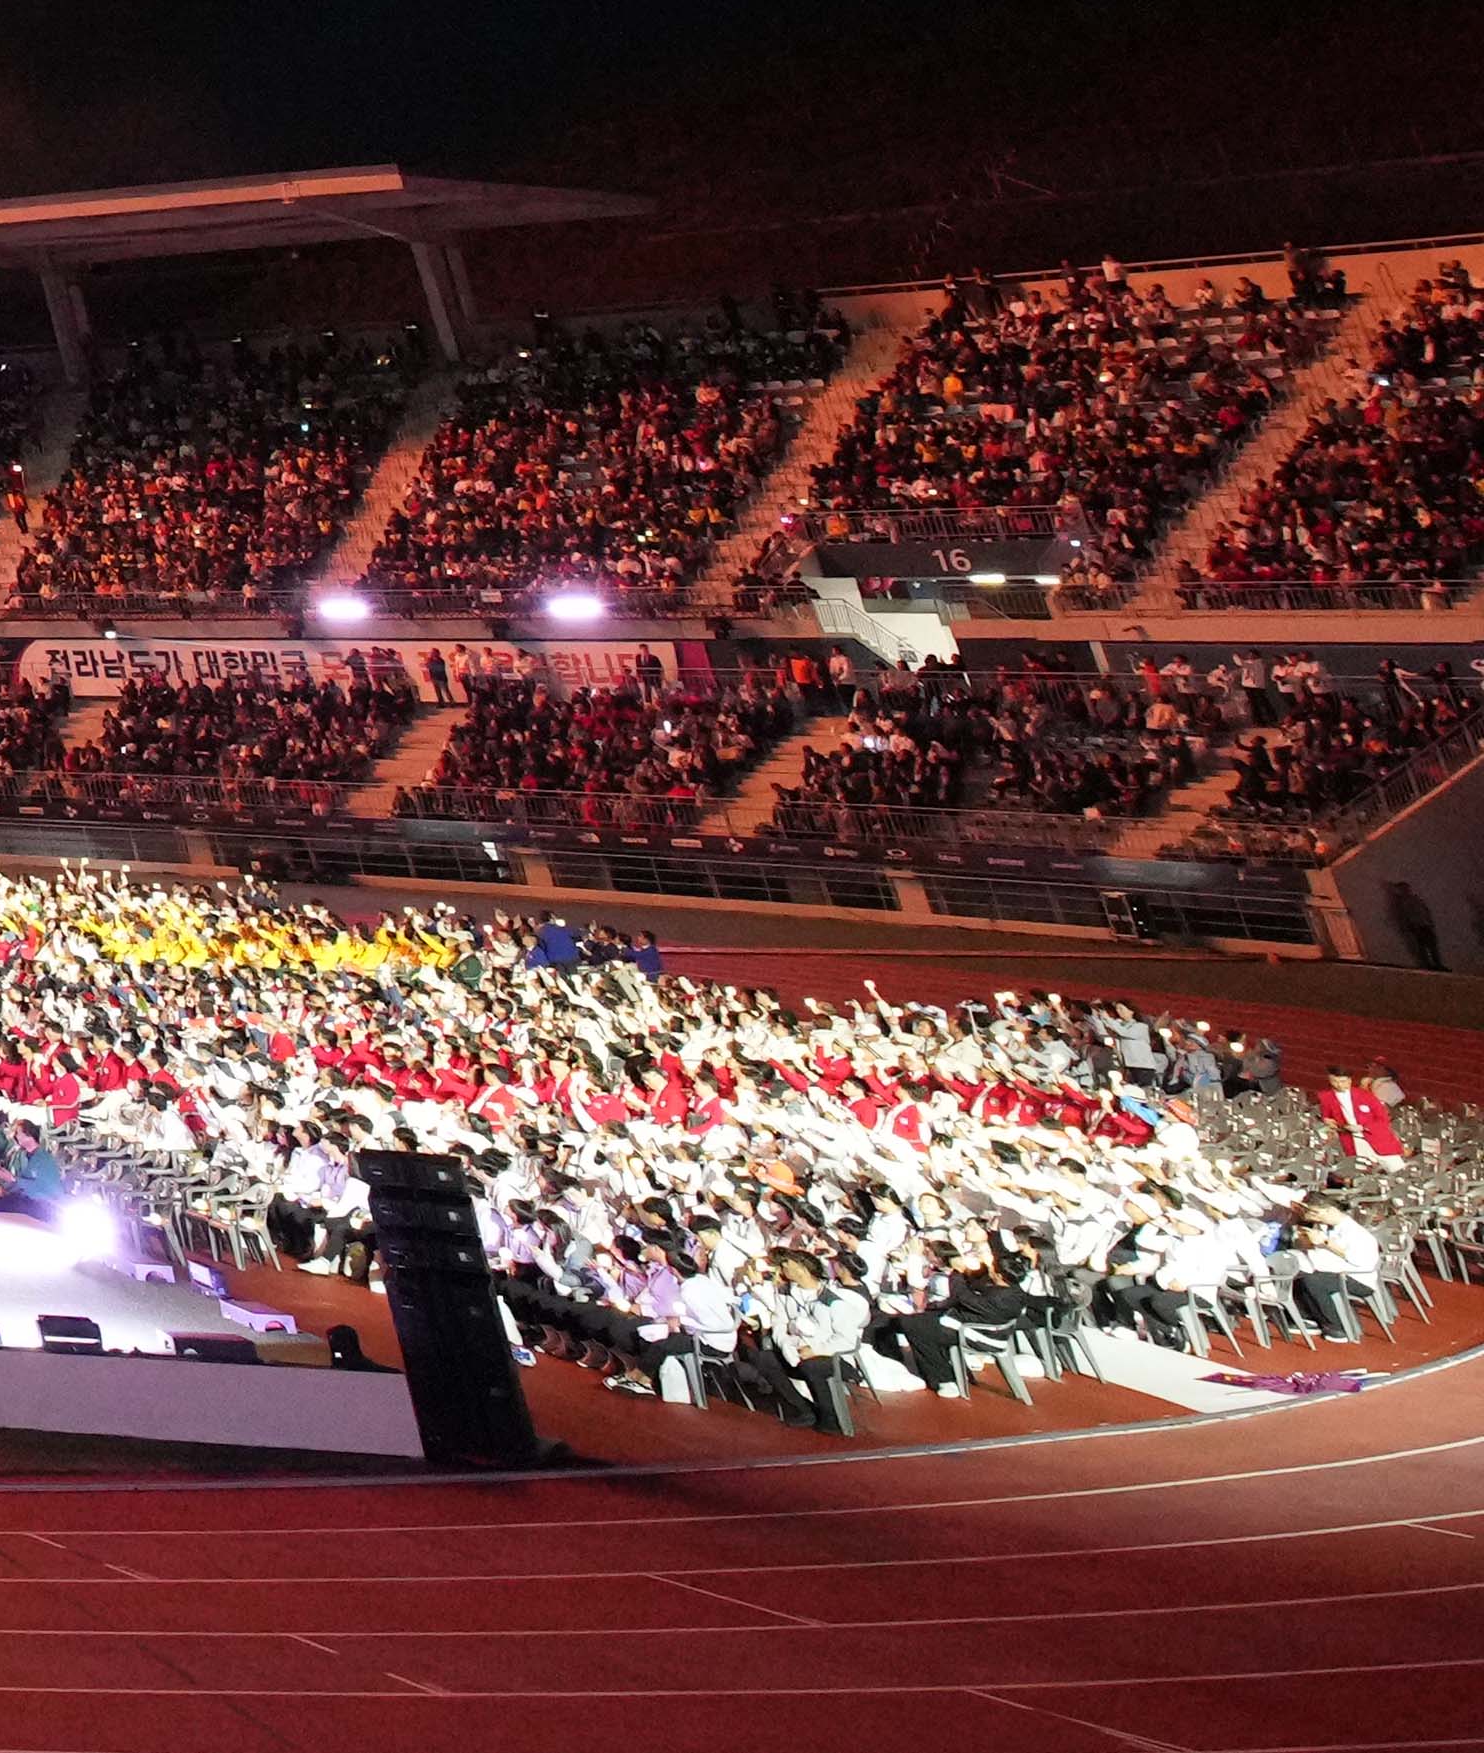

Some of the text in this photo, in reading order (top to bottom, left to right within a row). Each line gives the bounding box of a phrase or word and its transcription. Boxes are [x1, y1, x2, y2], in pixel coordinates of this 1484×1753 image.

[931, 548, 973, 573] 16
[45, 648, 184, 680] 전라남도가
[191, 649, 308, 680] 대한민국
